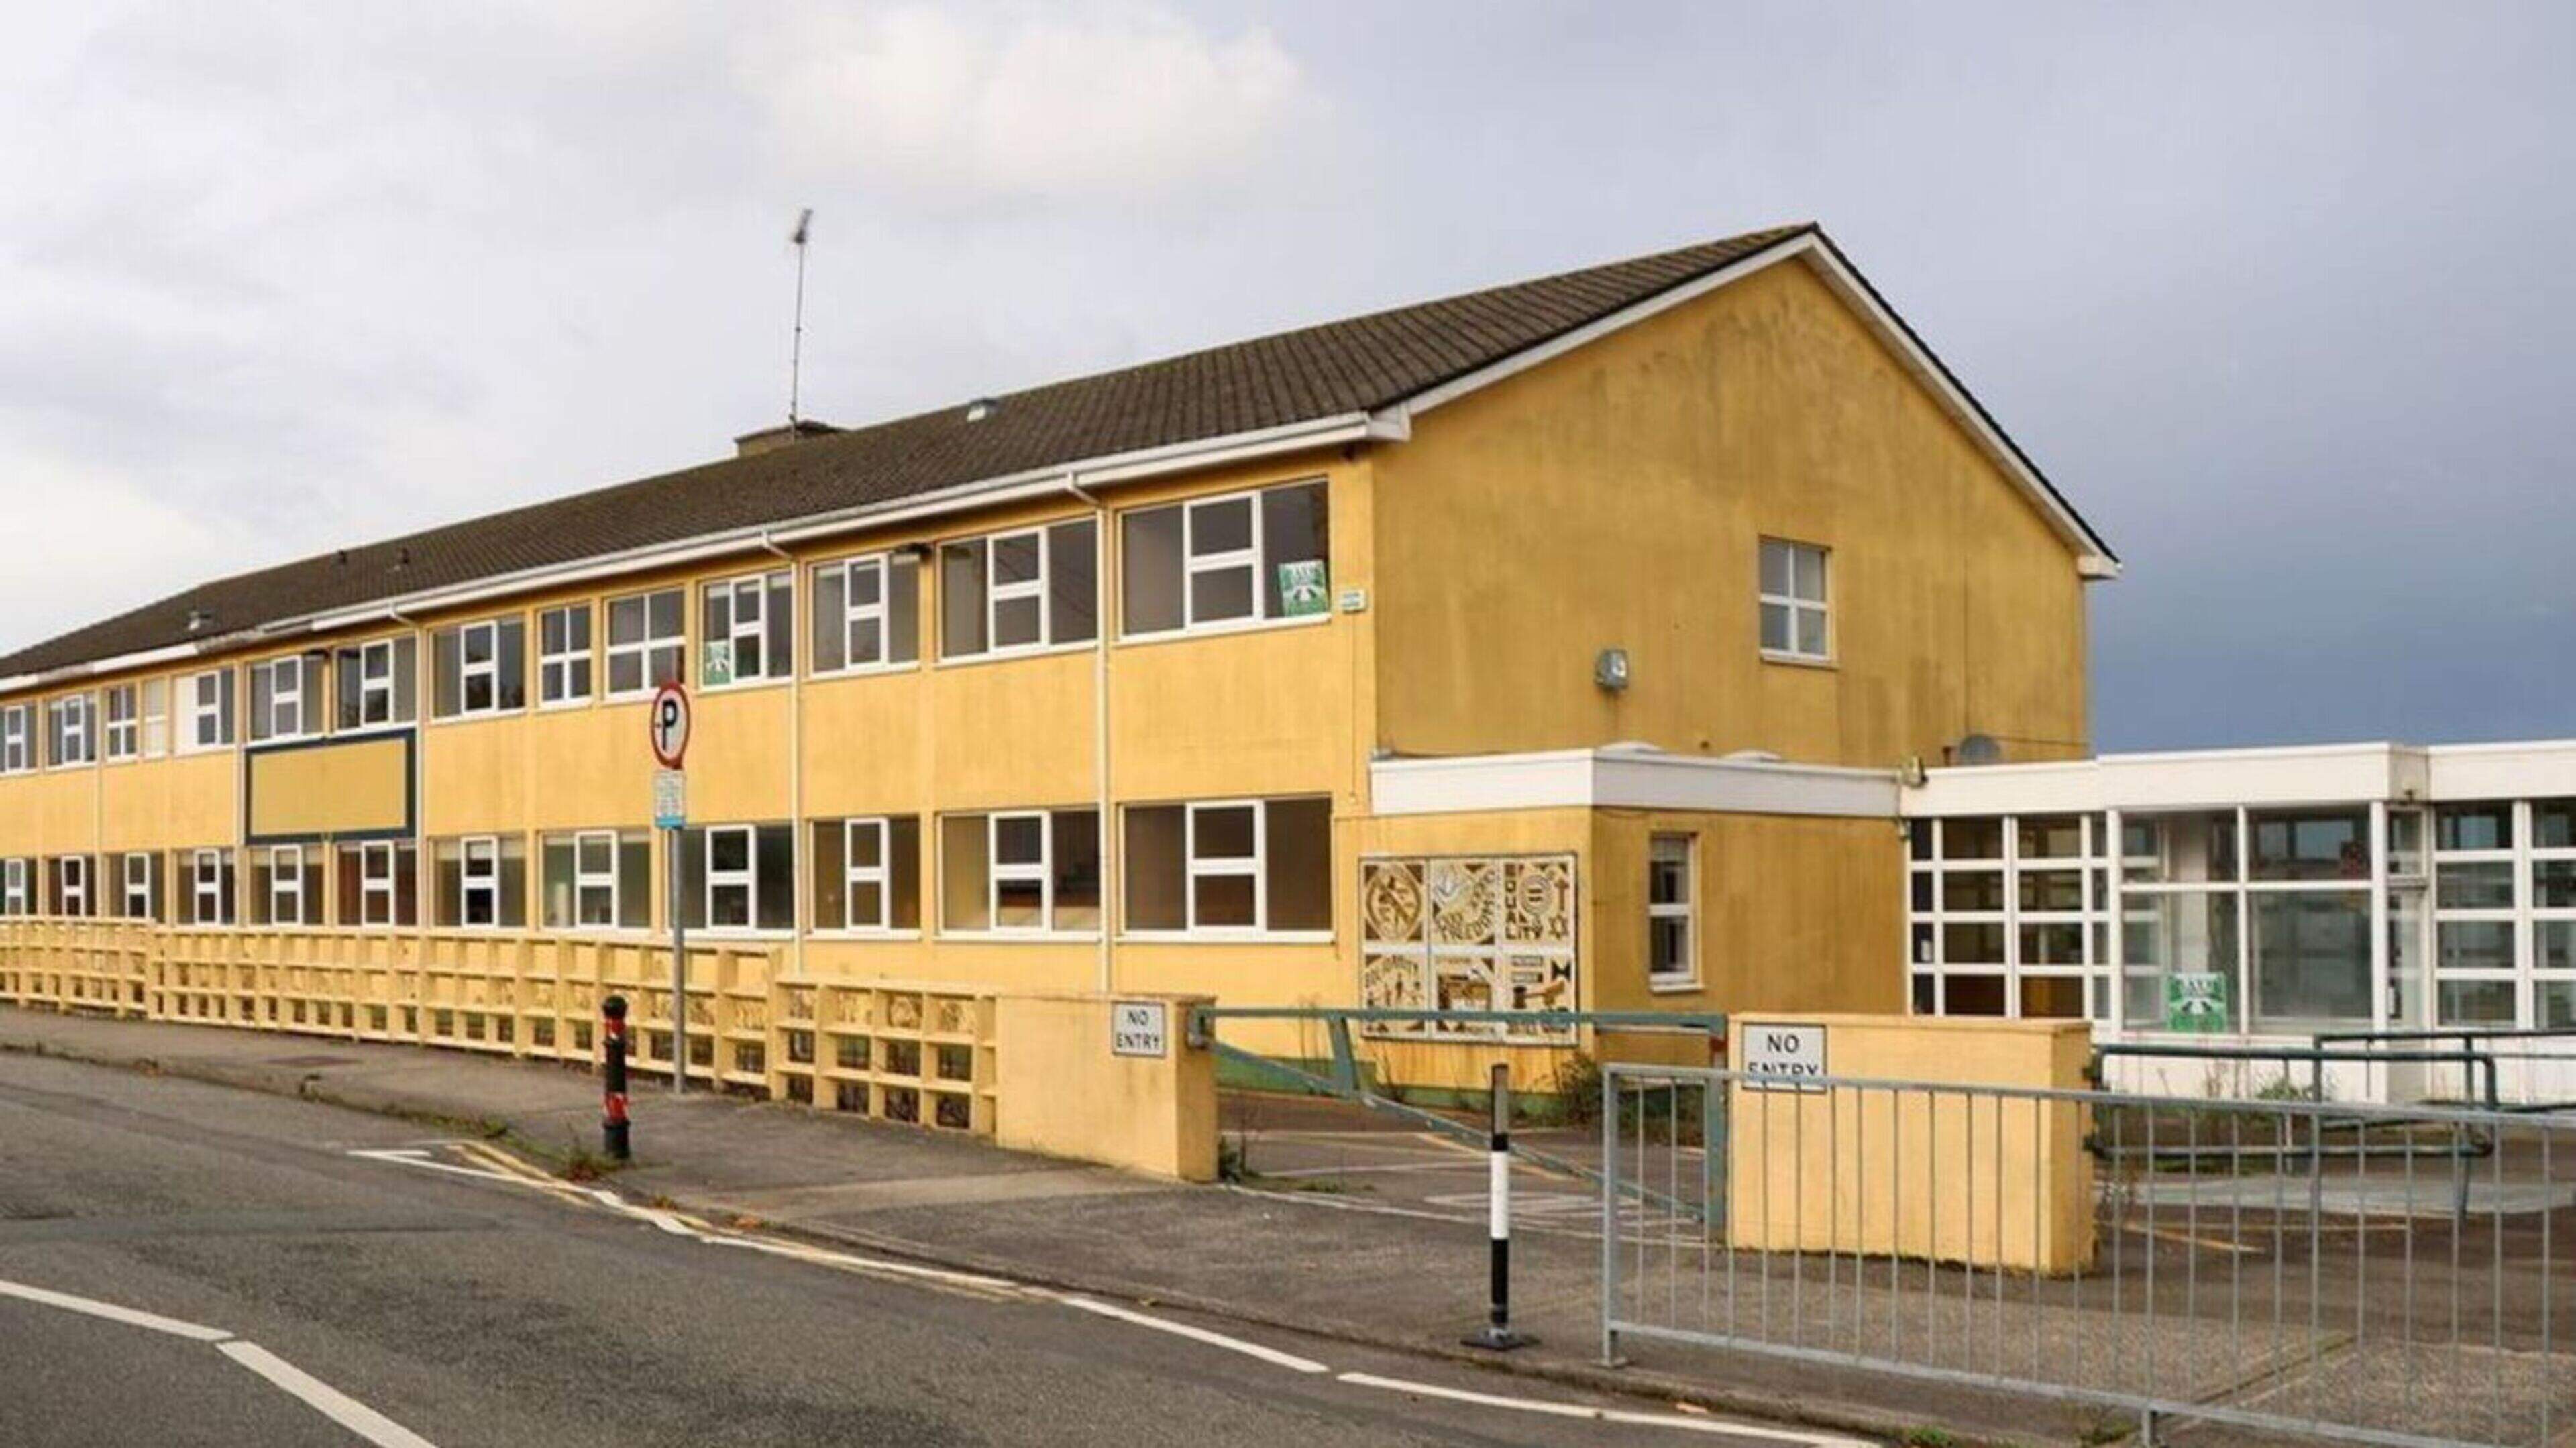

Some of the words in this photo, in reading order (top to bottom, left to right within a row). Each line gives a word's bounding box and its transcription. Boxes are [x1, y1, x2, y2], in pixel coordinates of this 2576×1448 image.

[1128, 1009, 1149, 1025] NO
[1116, 1032, 1159, 1050] ENTRY
[1768, 1034, 1799, 1053] NO
